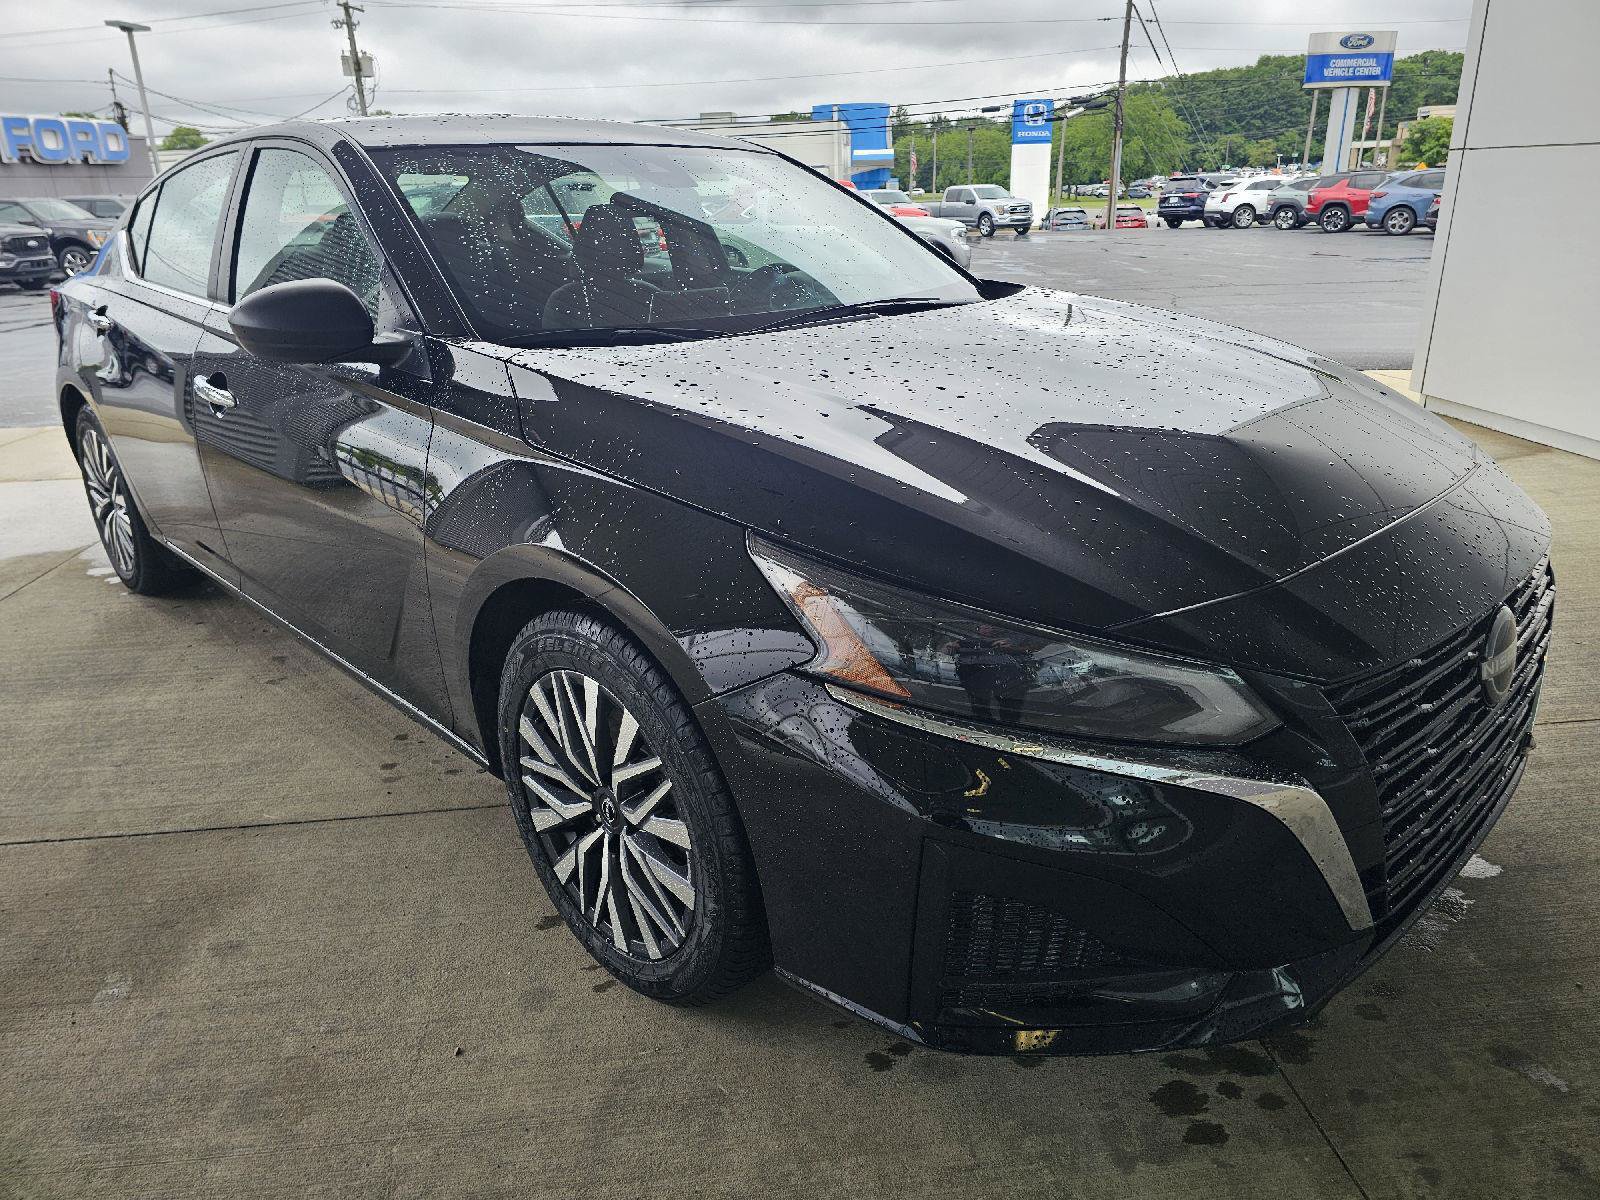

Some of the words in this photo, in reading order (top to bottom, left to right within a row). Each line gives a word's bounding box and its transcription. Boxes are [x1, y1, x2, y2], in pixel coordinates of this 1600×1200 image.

[1330, 58, 1377, 67] COMMERCIAL
[1323, 67, 1354, 76] VEHICLE
[1354, 66, 1381, 75] CENTER
[1017, 130, 1051, 138] HONDA
[1, 115, 130, 164] FORD
